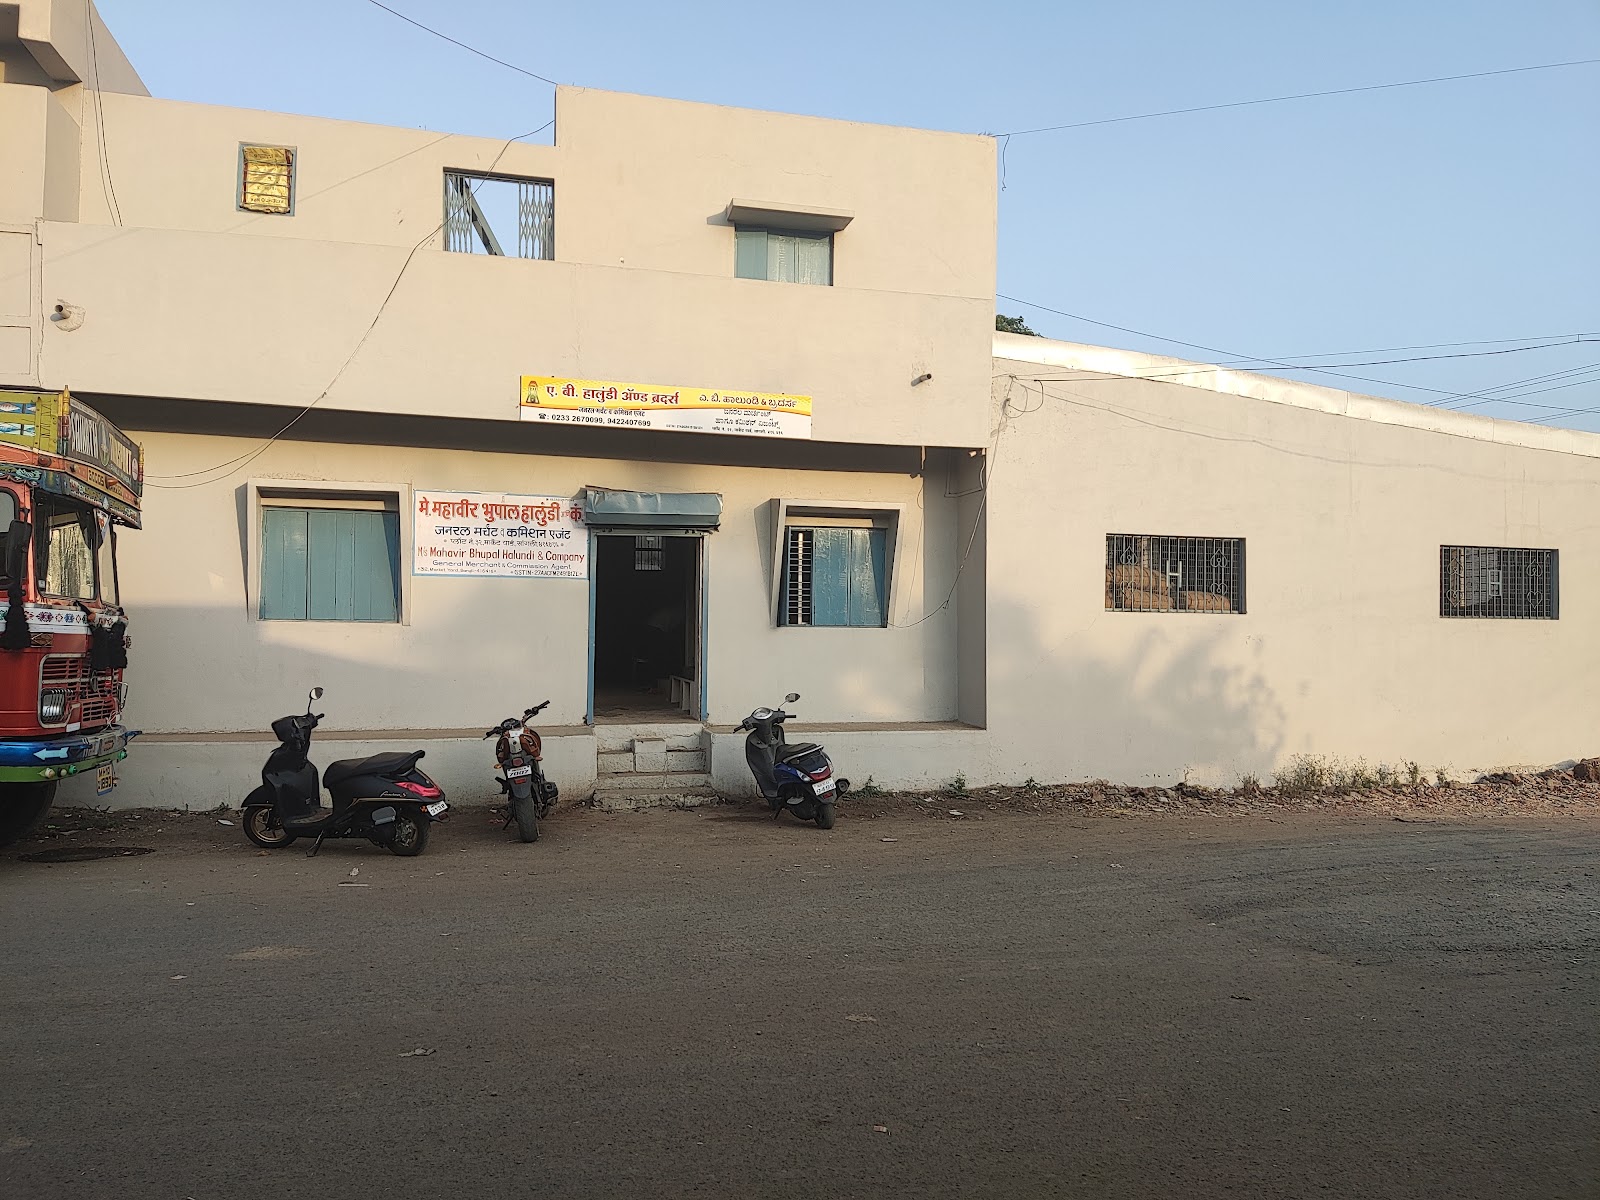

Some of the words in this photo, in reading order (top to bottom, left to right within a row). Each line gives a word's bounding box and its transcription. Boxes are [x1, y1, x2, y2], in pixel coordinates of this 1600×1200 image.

[583, 386, 618, 403] हालुंडी
[651, 391, 680, 406] ब्रदर्स
[432, 498, 480, 520] महावीर
[435, 526, 470, 537] जनरल
[507, 525, 547, 539] कमिशन
[430, 546, 467, 559] Mahavir
[469, 548, 500, 561] Bhupal
[502, 549, 535, 561] Halundi
[537, 551, 544, 561] &
[545, 550, 585, 564] Company
[432, 560, 464, 568] General
[466, 561, 500, 569] Merchant
[507, 561, 549, 570] Commission
[551, 563, 572, 571] Agent
